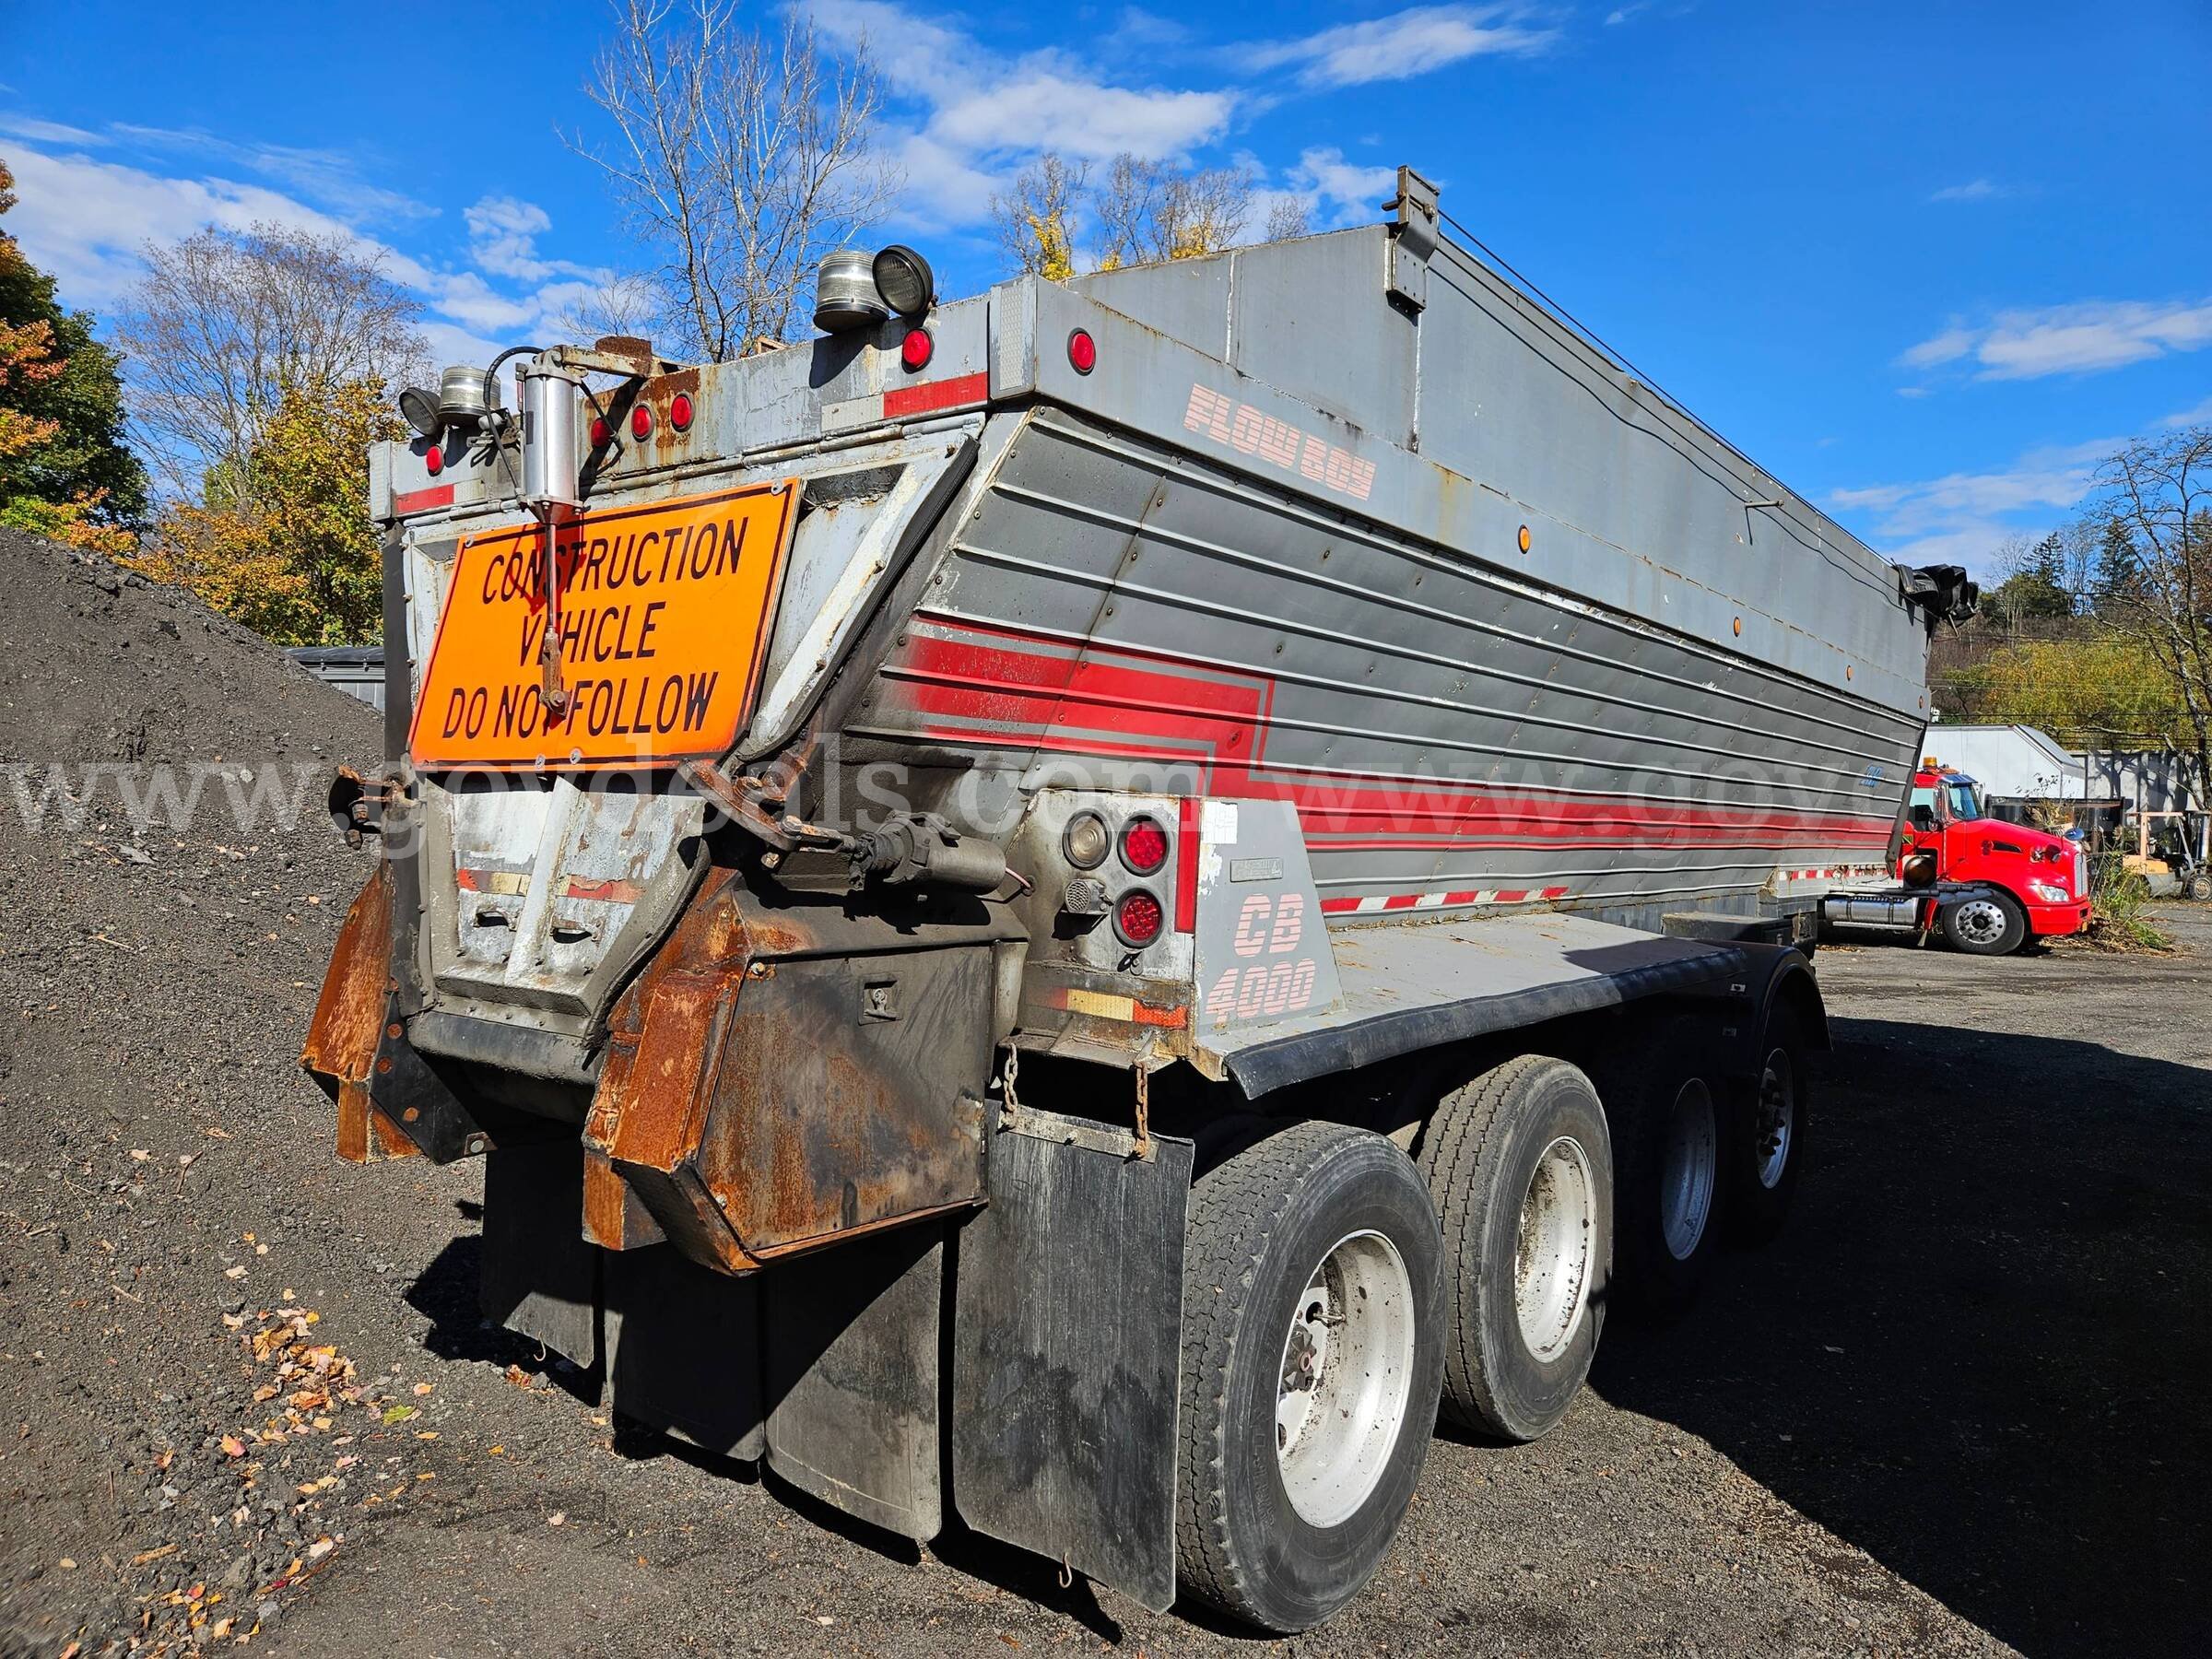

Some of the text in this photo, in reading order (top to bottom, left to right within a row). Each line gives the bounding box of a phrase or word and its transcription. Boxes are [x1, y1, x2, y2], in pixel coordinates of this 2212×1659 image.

[1183, 382, 1377, 501] FLOW BOY
[482, 516, 749, 605] CONSTRUCTION
[442, 686, 488, 740] DO
[566, 671, 720, 736] FOLLOW
[1234, 893, 1304, 958] CB
[1205, 958, 1316, 1024] 4000
